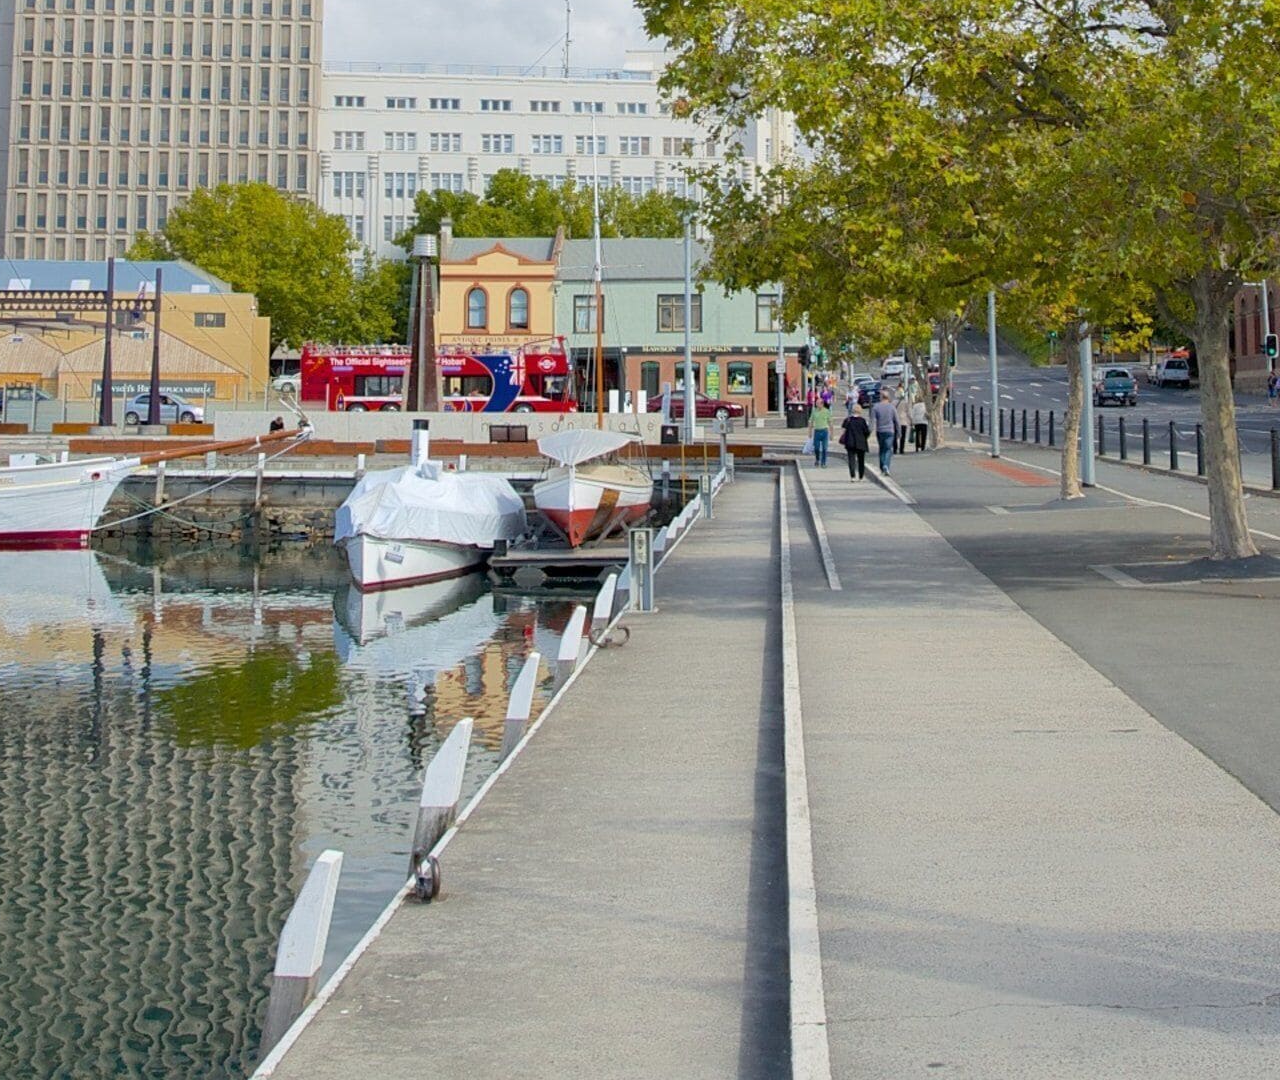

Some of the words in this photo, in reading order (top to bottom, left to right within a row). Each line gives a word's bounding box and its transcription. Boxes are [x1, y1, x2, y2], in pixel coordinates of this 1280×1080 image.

[690, 344, 732, 353] HEEPSKIN
[330, 357, 344, 366] The
[345, 357, 370, 366] Official
[372, 357, 411, 368] Sightseei
[441, 357, 466, 366] Hobart
[96, 384, 135, 393] Mwson's
